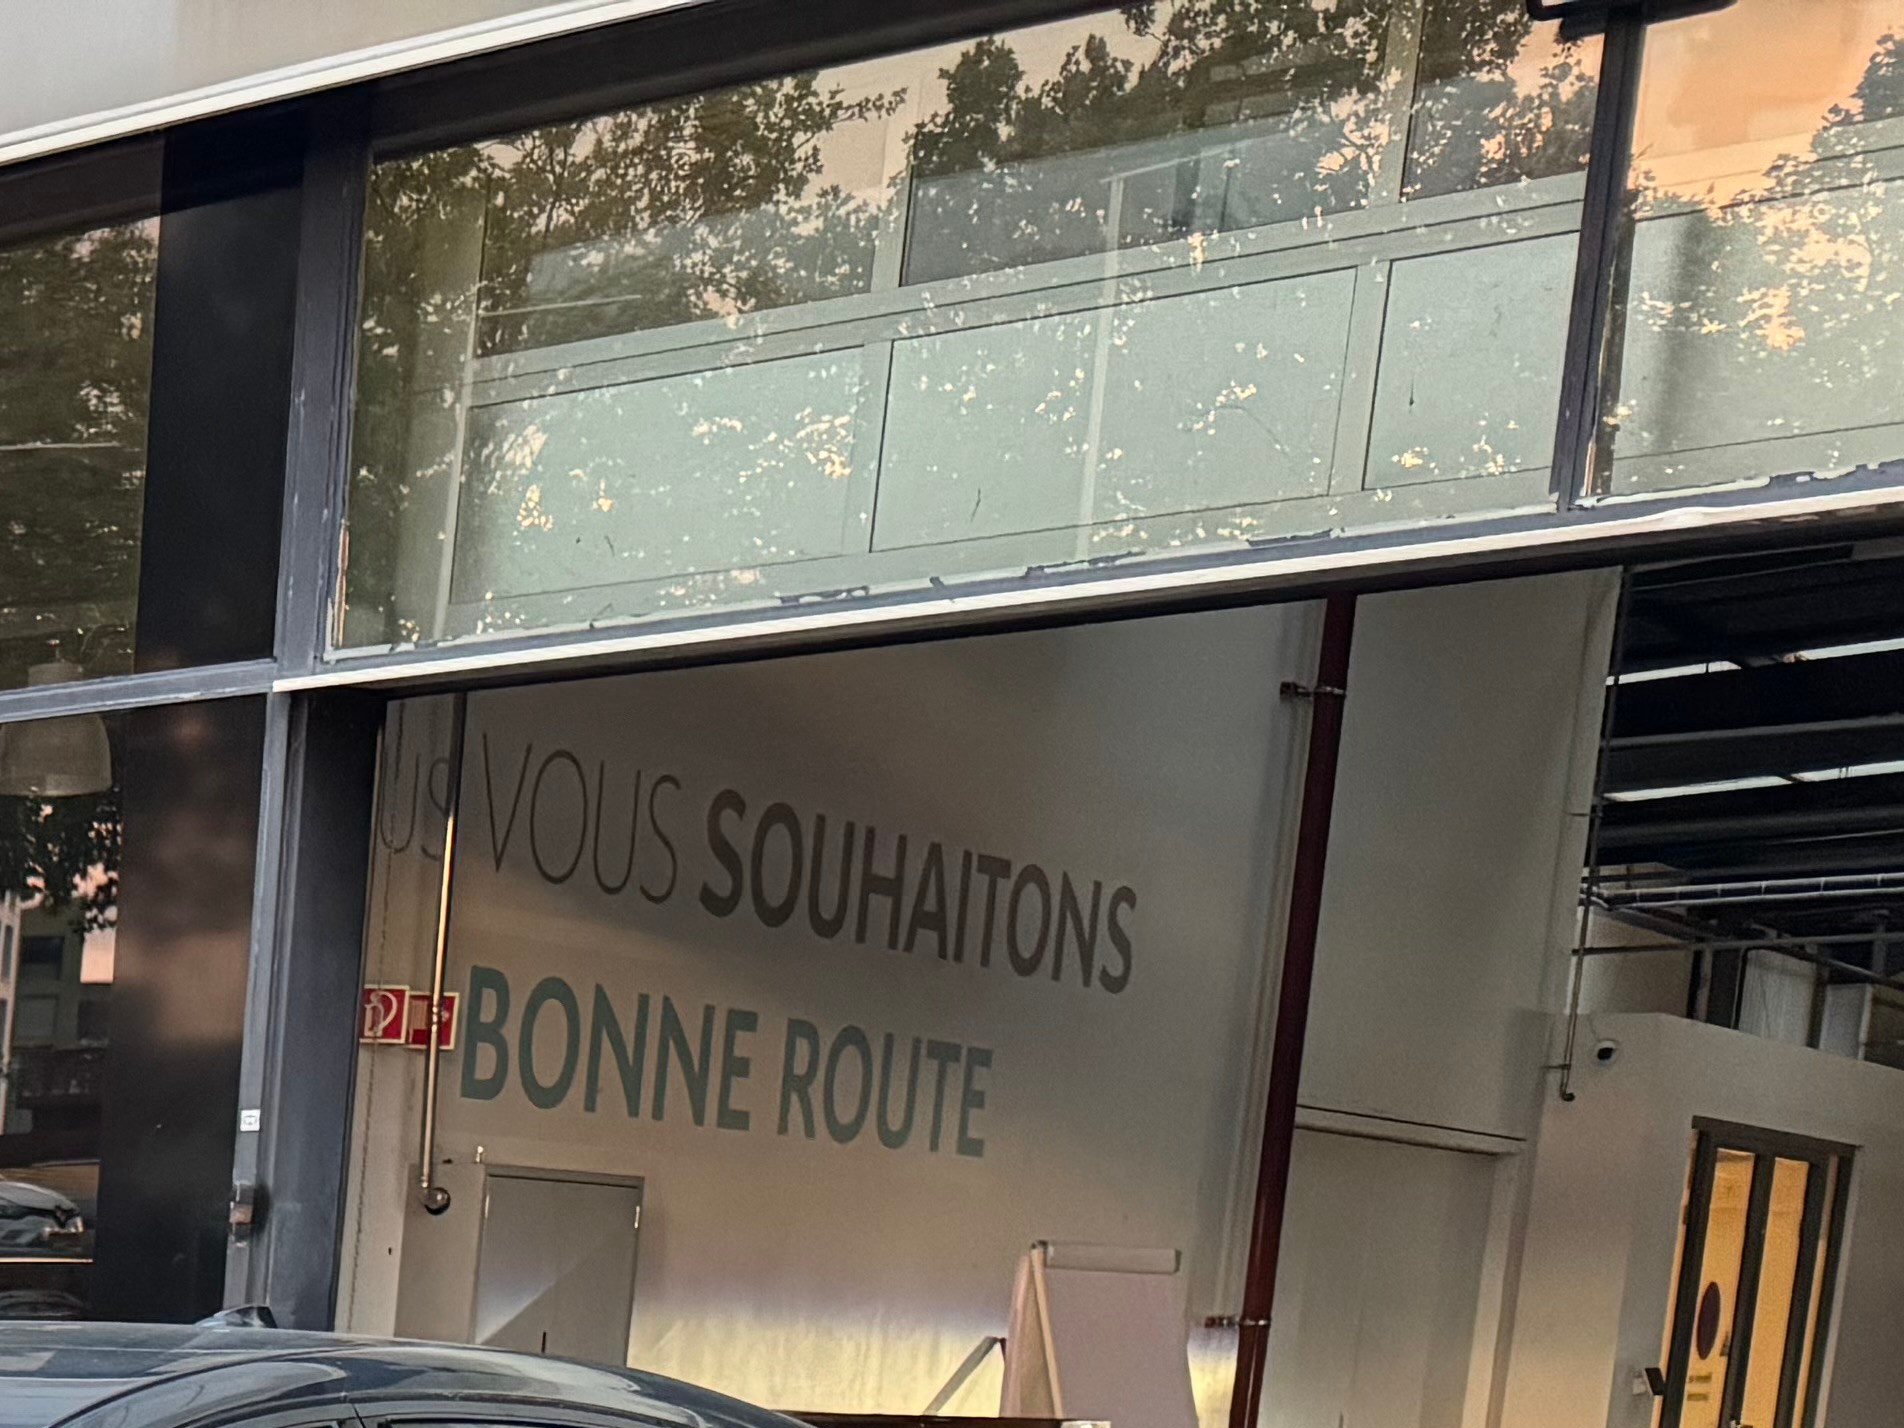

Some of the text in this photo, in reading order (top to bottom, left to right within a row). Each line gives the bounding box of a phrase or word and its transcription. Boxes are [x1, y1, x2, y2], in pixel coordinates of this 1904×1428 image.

[480, 732, 682, 904] VOUS
[699, 789, 1137, 994] SOUHAITONS
[459, 964, 994, 1158] BONNE ROUTE
